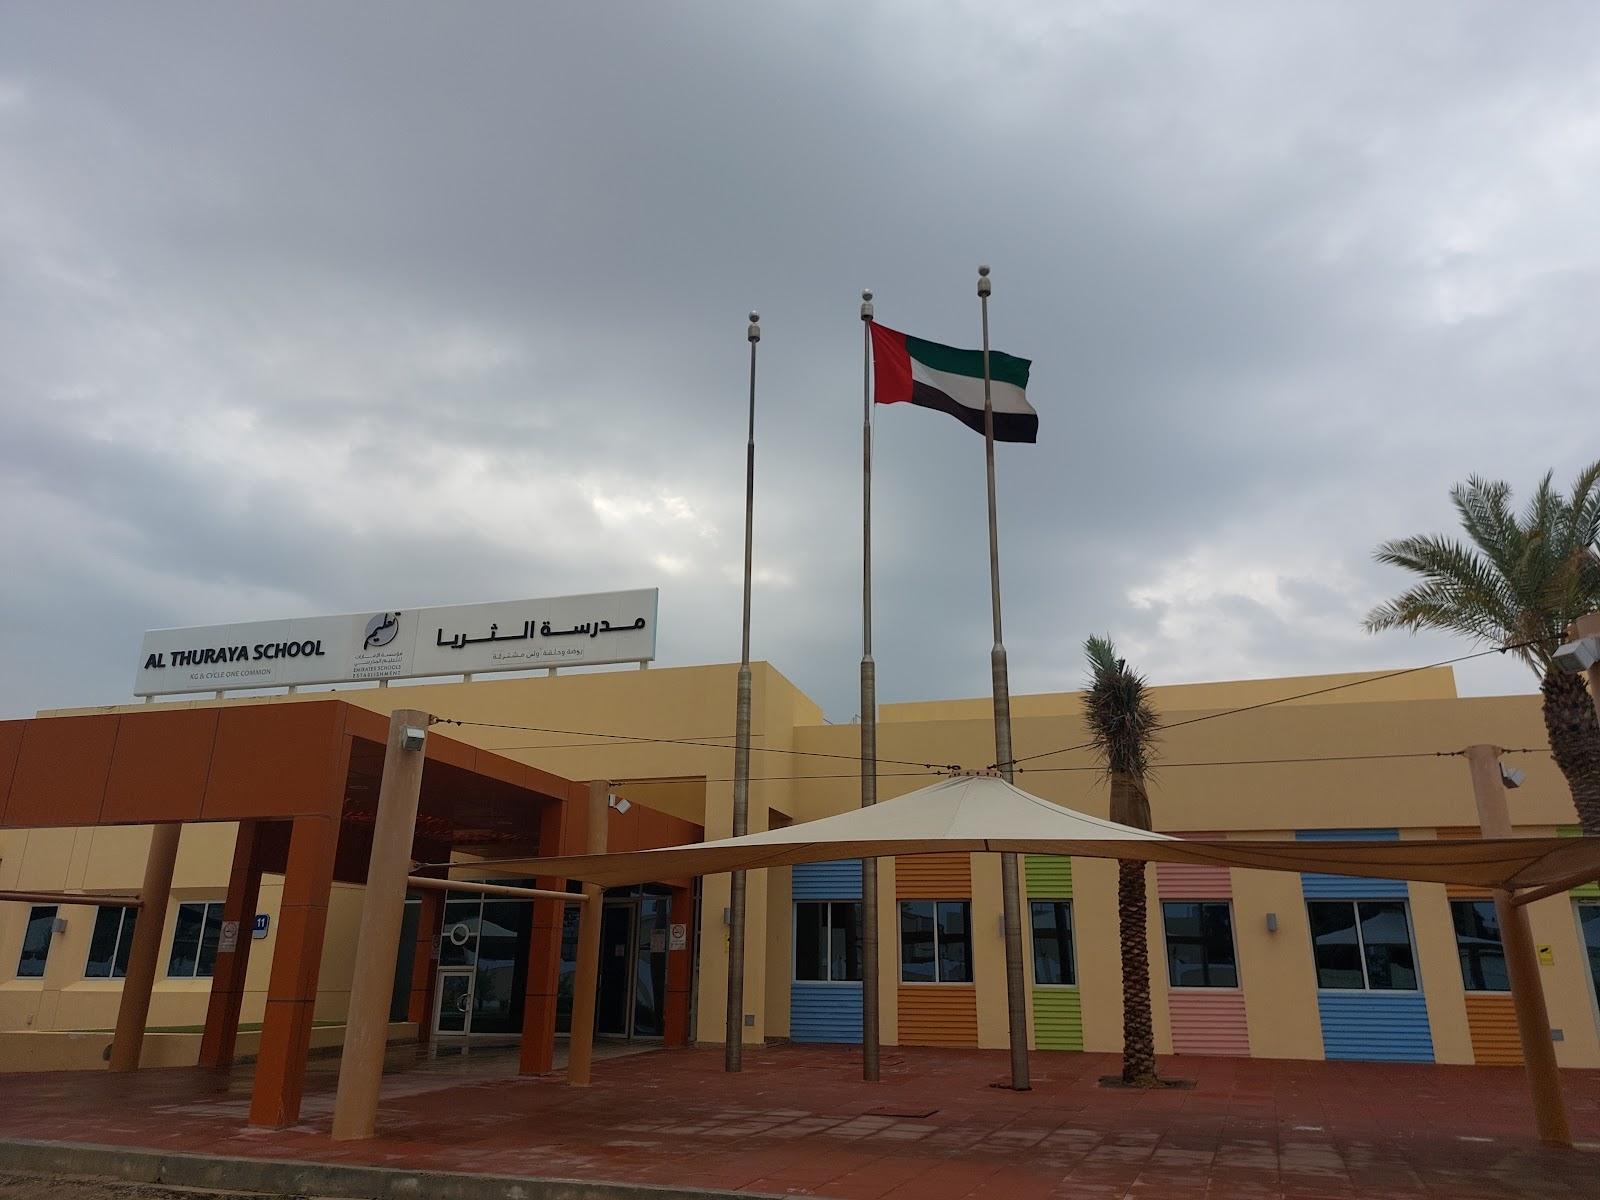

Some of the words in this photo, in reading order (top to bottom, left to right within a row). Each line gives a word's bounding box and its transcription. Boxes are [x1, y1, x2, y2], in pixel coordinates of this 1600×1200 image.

[436, 620, 535, 649] الثريا
[540, 617, 646, 638] مدرسة
[144, 653, 166, 669] AL
[171, 646, 249, 667] THURAYA
[252, 640, 325, 660] SCHOOL
[205, 671, 225, 679] CYCLE
[225, 670, 241, 678] ONE
[240, 668, 272, 677] COMMON
[352, 670, 401, 679] ESTABLISHMENT
[257, 917, 266, 928] 11
